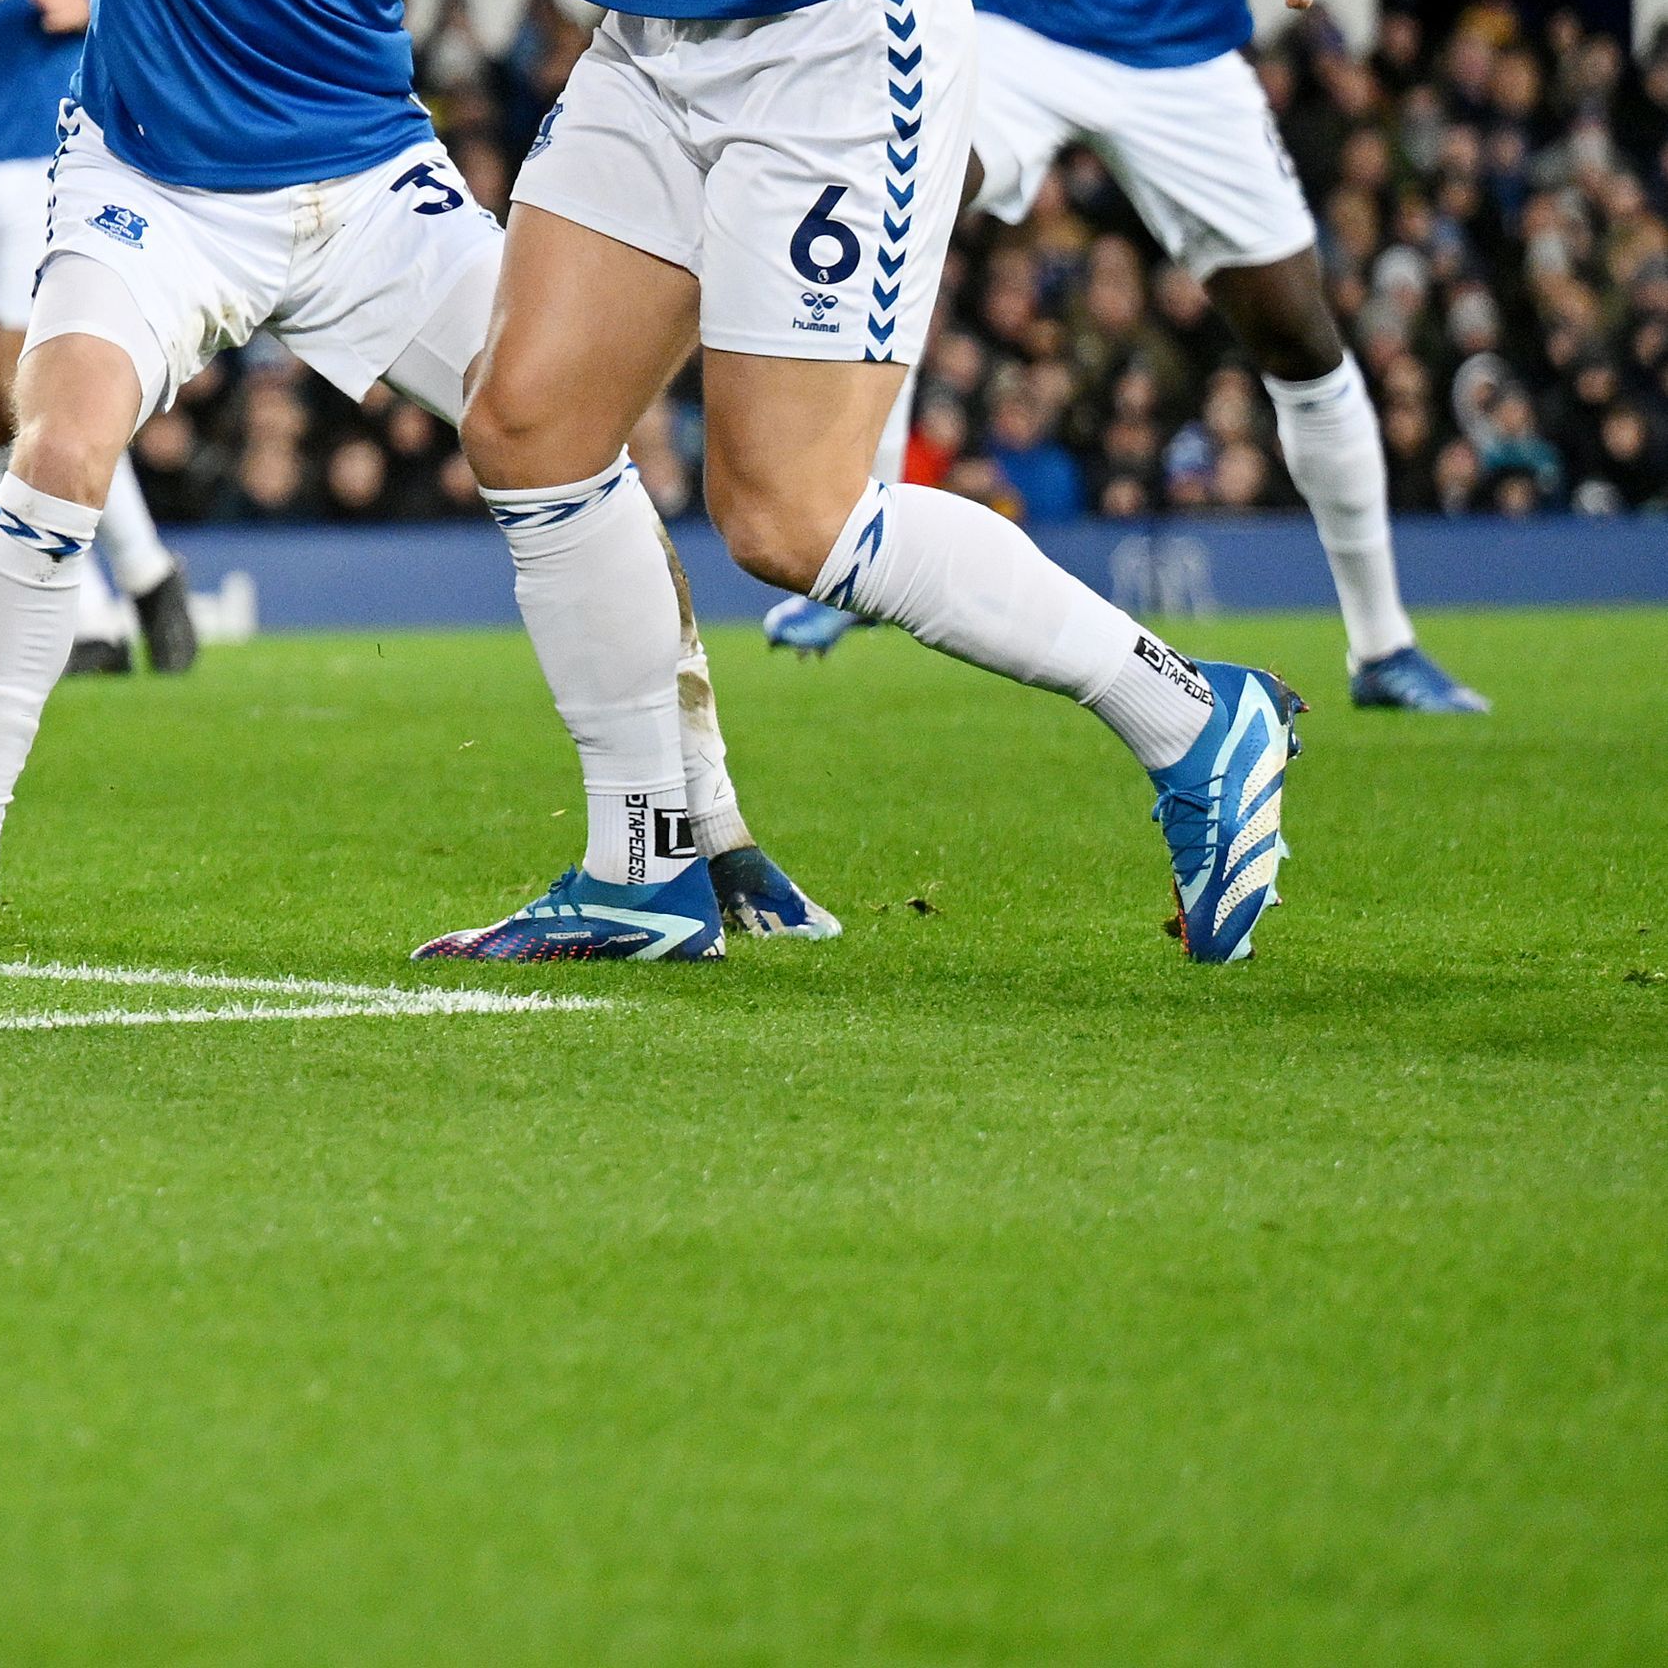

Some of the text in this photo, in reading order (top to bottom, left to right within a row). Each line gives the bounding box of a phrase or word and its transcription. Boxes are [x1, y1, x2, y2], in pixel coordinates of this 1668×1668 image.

[389, 160, 464, 215] 3
[790, 185, 861, 284] 6
[792, 317, 840, 333] hummel
